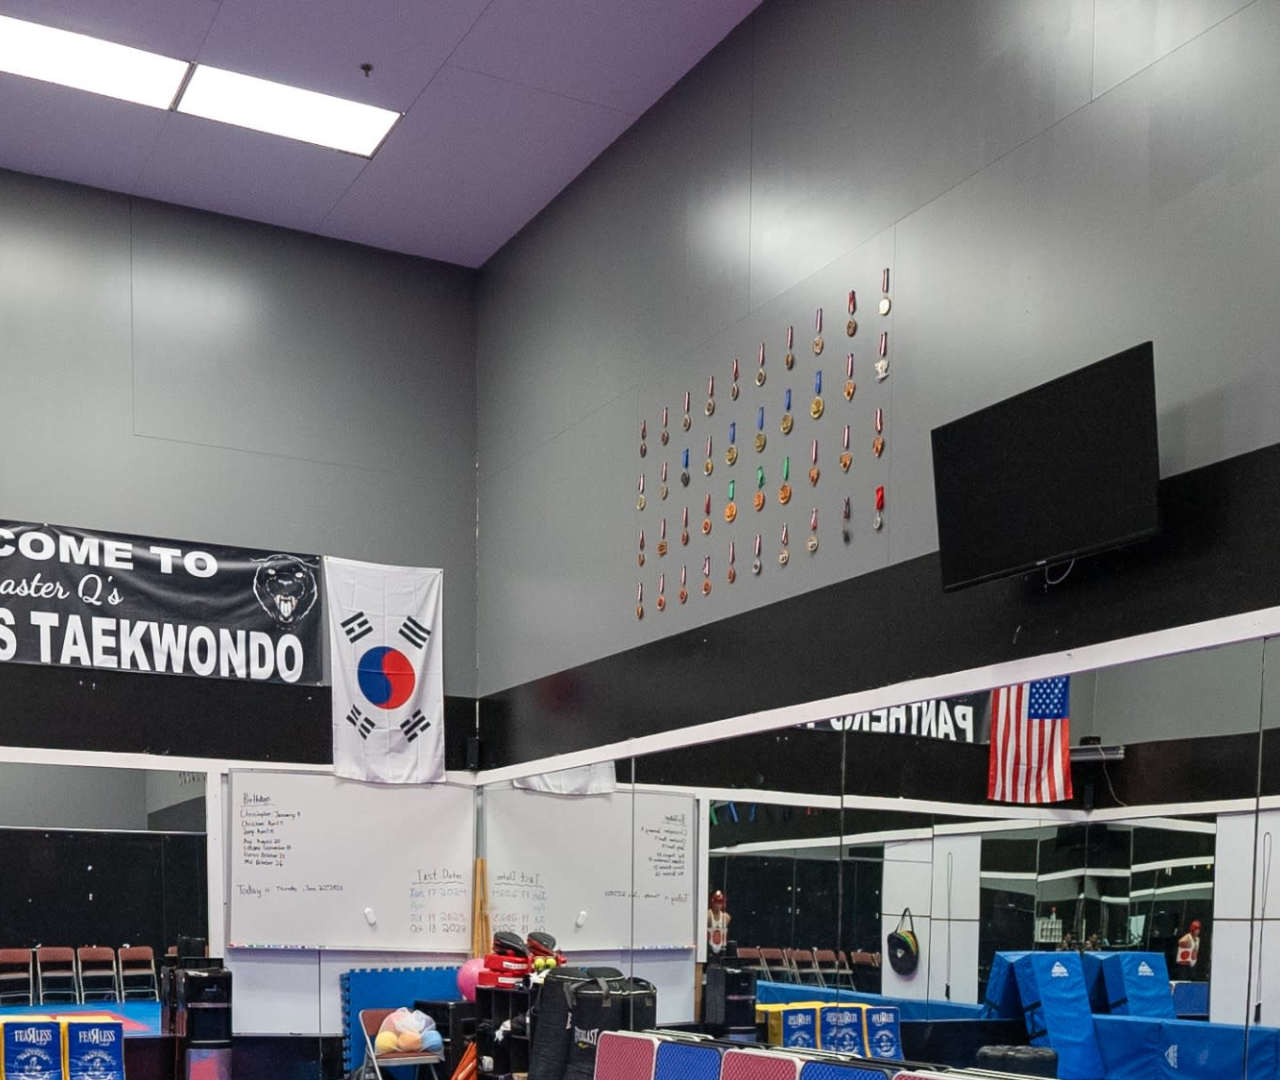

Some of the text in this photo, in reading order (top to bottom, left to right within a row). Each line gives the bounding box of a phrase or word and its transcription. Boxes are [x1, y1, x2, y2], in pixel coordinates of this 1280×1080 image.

[150, 546, 218, 578] TO
[77, 574, 124, 605] Q's
[30, 611, 304, 683] TAEKWONDO
[14, 1027, 52, 1043] FEARLESS
[79, 1028, 116, 1044] FEARLESS
